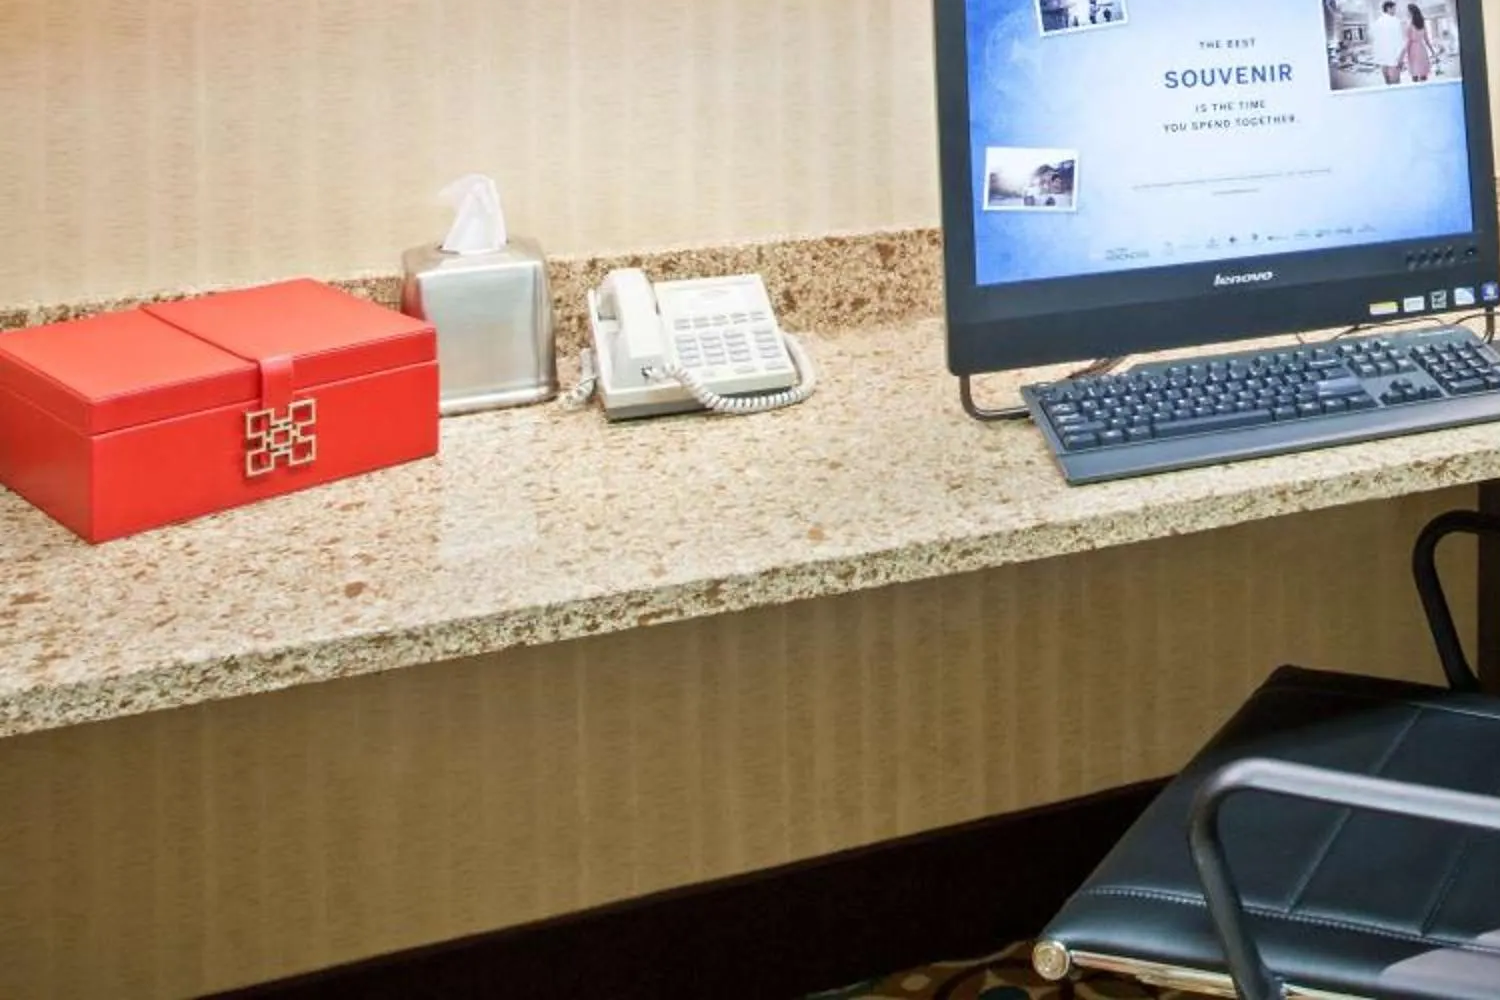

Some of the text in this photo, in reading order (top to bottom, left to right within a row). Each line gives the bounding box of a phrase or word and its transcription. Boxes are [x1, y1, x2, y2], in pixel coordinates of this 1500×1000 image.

[1200, 40, 1221, 49] THE
[1164, 63, 1293, 89] SOUVENIR
[1195, 99, 1266, 113] IS THE TIME
[1163, 122, 1187, 133] YOU
[1191, 119, 1231, 131] SPEND
[1213, 271, 1273, 287] lenovo
